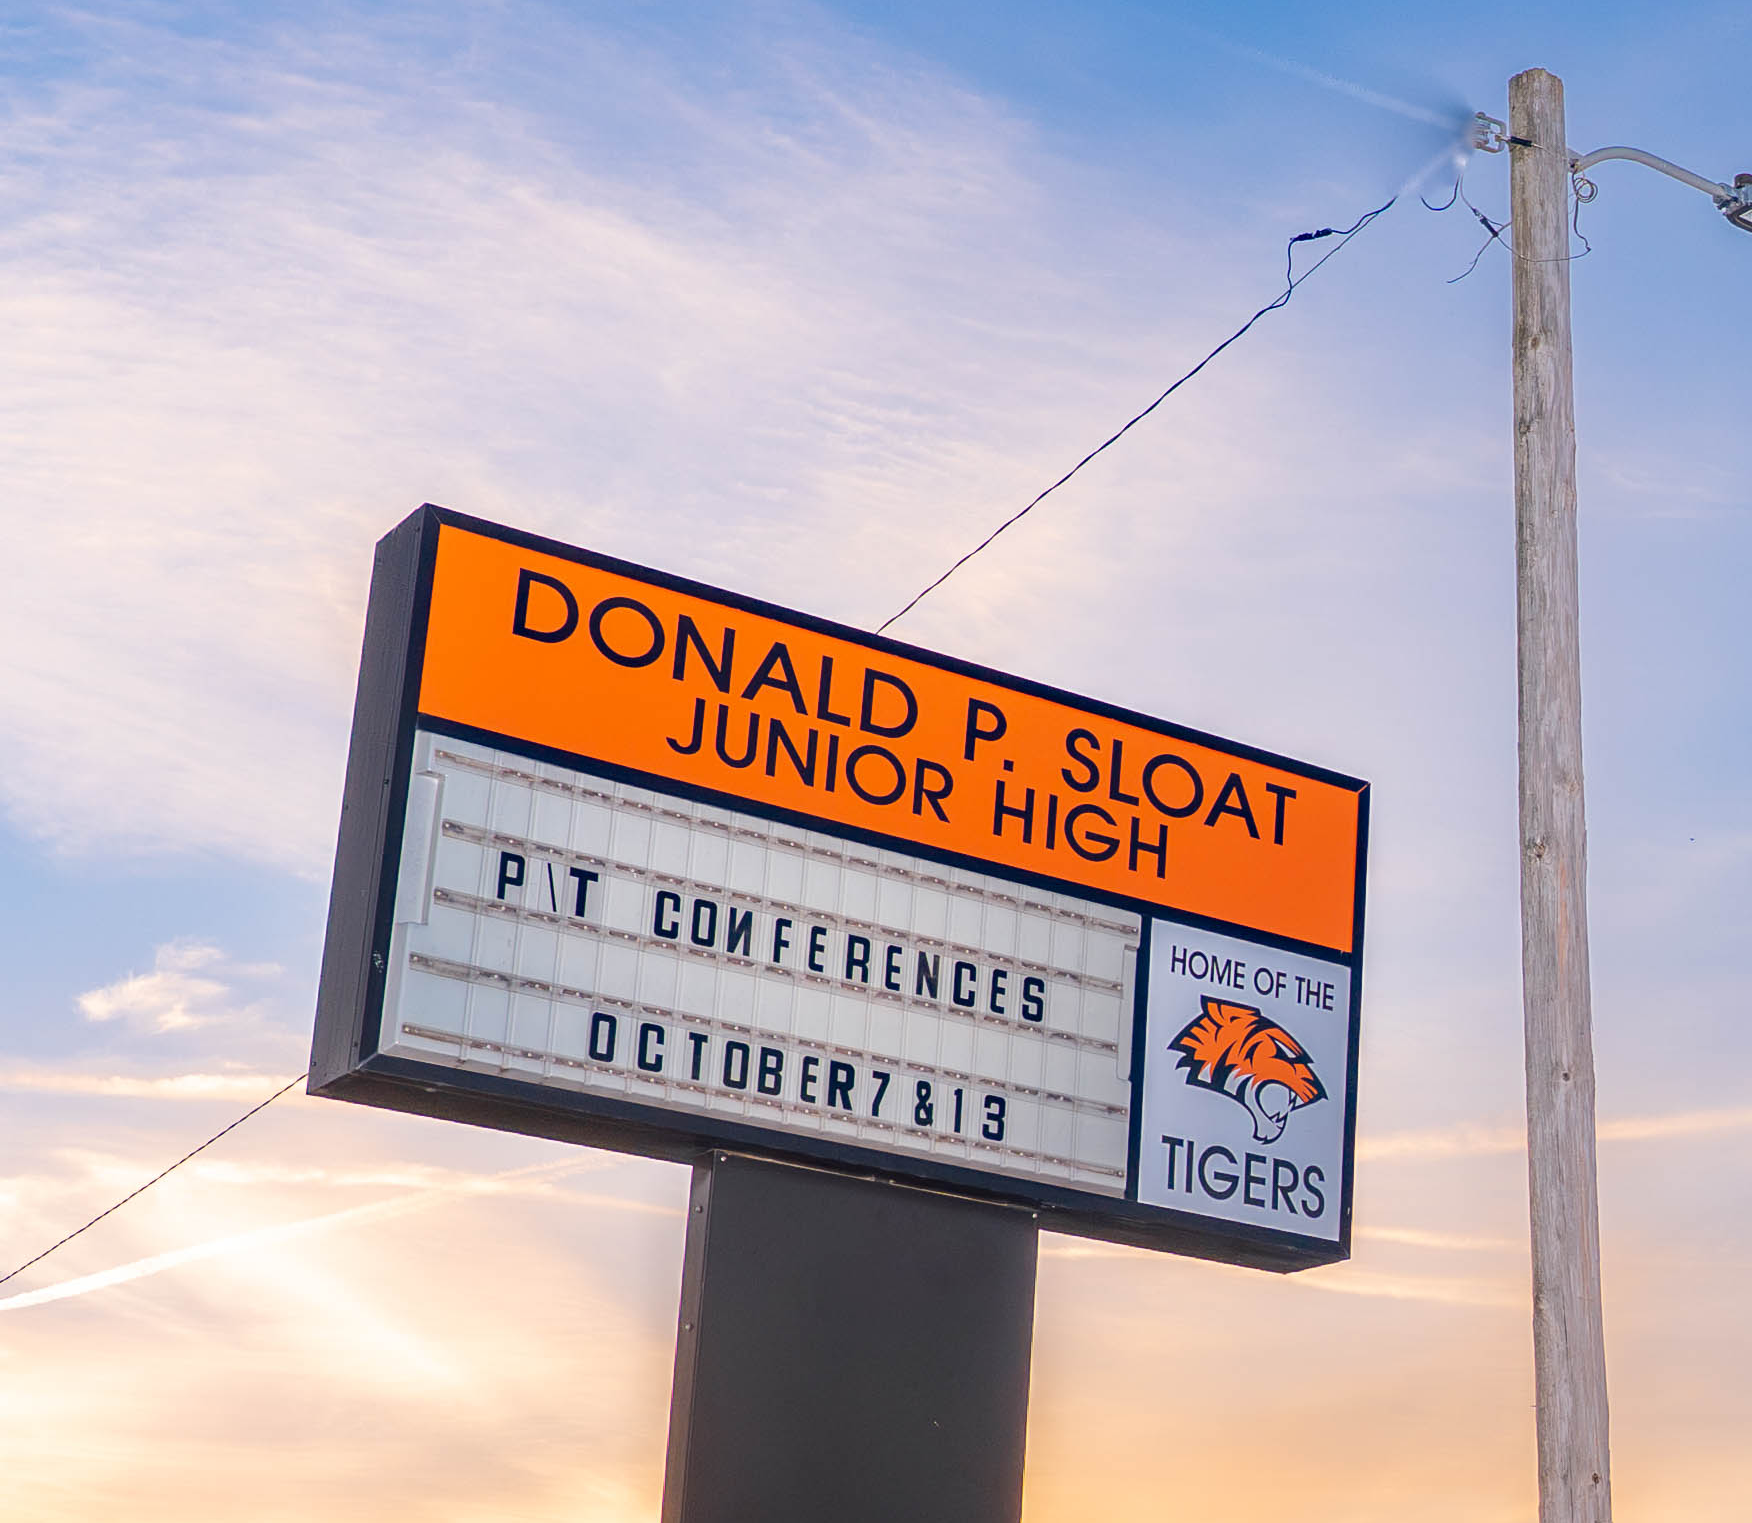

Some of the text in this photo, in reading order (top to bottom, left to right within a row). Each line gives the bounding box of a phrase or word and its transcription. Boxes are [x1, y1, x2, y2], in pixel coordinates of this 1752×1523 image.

[512, 567, 1298, 847] DONALD P. SLOAT
[665, 697, 1169, 880] JUNIOR HIGH
[653, 890, 1045, 1023] CONFERENCES
[1170, 945, 1335, 1011] HOME OF THE
[1161, 1134, 1326, 1219] TIGERS
